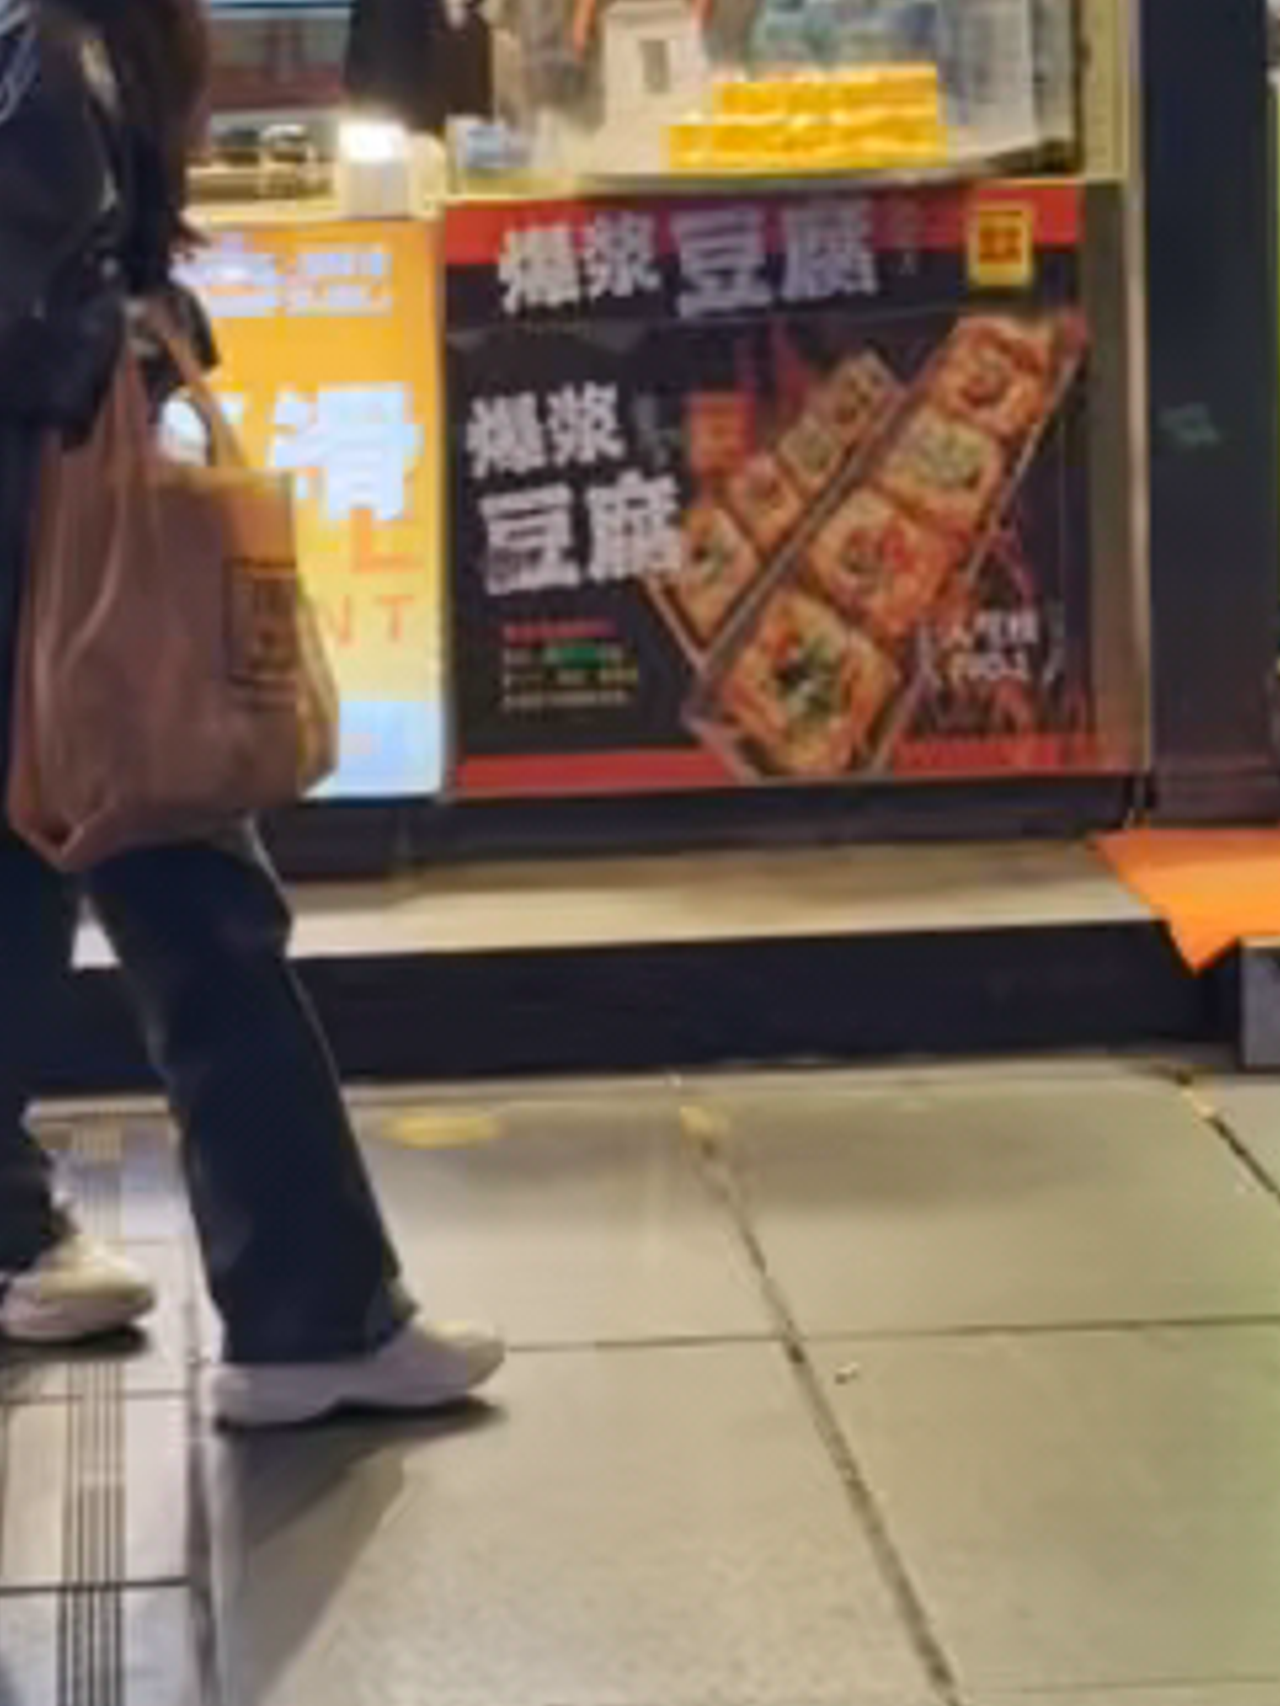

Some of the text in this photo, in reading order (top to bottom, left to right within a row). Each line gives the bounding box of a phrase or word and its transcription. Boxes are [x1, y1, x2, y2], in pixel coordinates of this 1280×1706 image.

[499, 200, 879, 319] 爆浆豆腐
[466, 382, 625, 478] 爆浆
[478, 470, 684, 596] 豆腐
